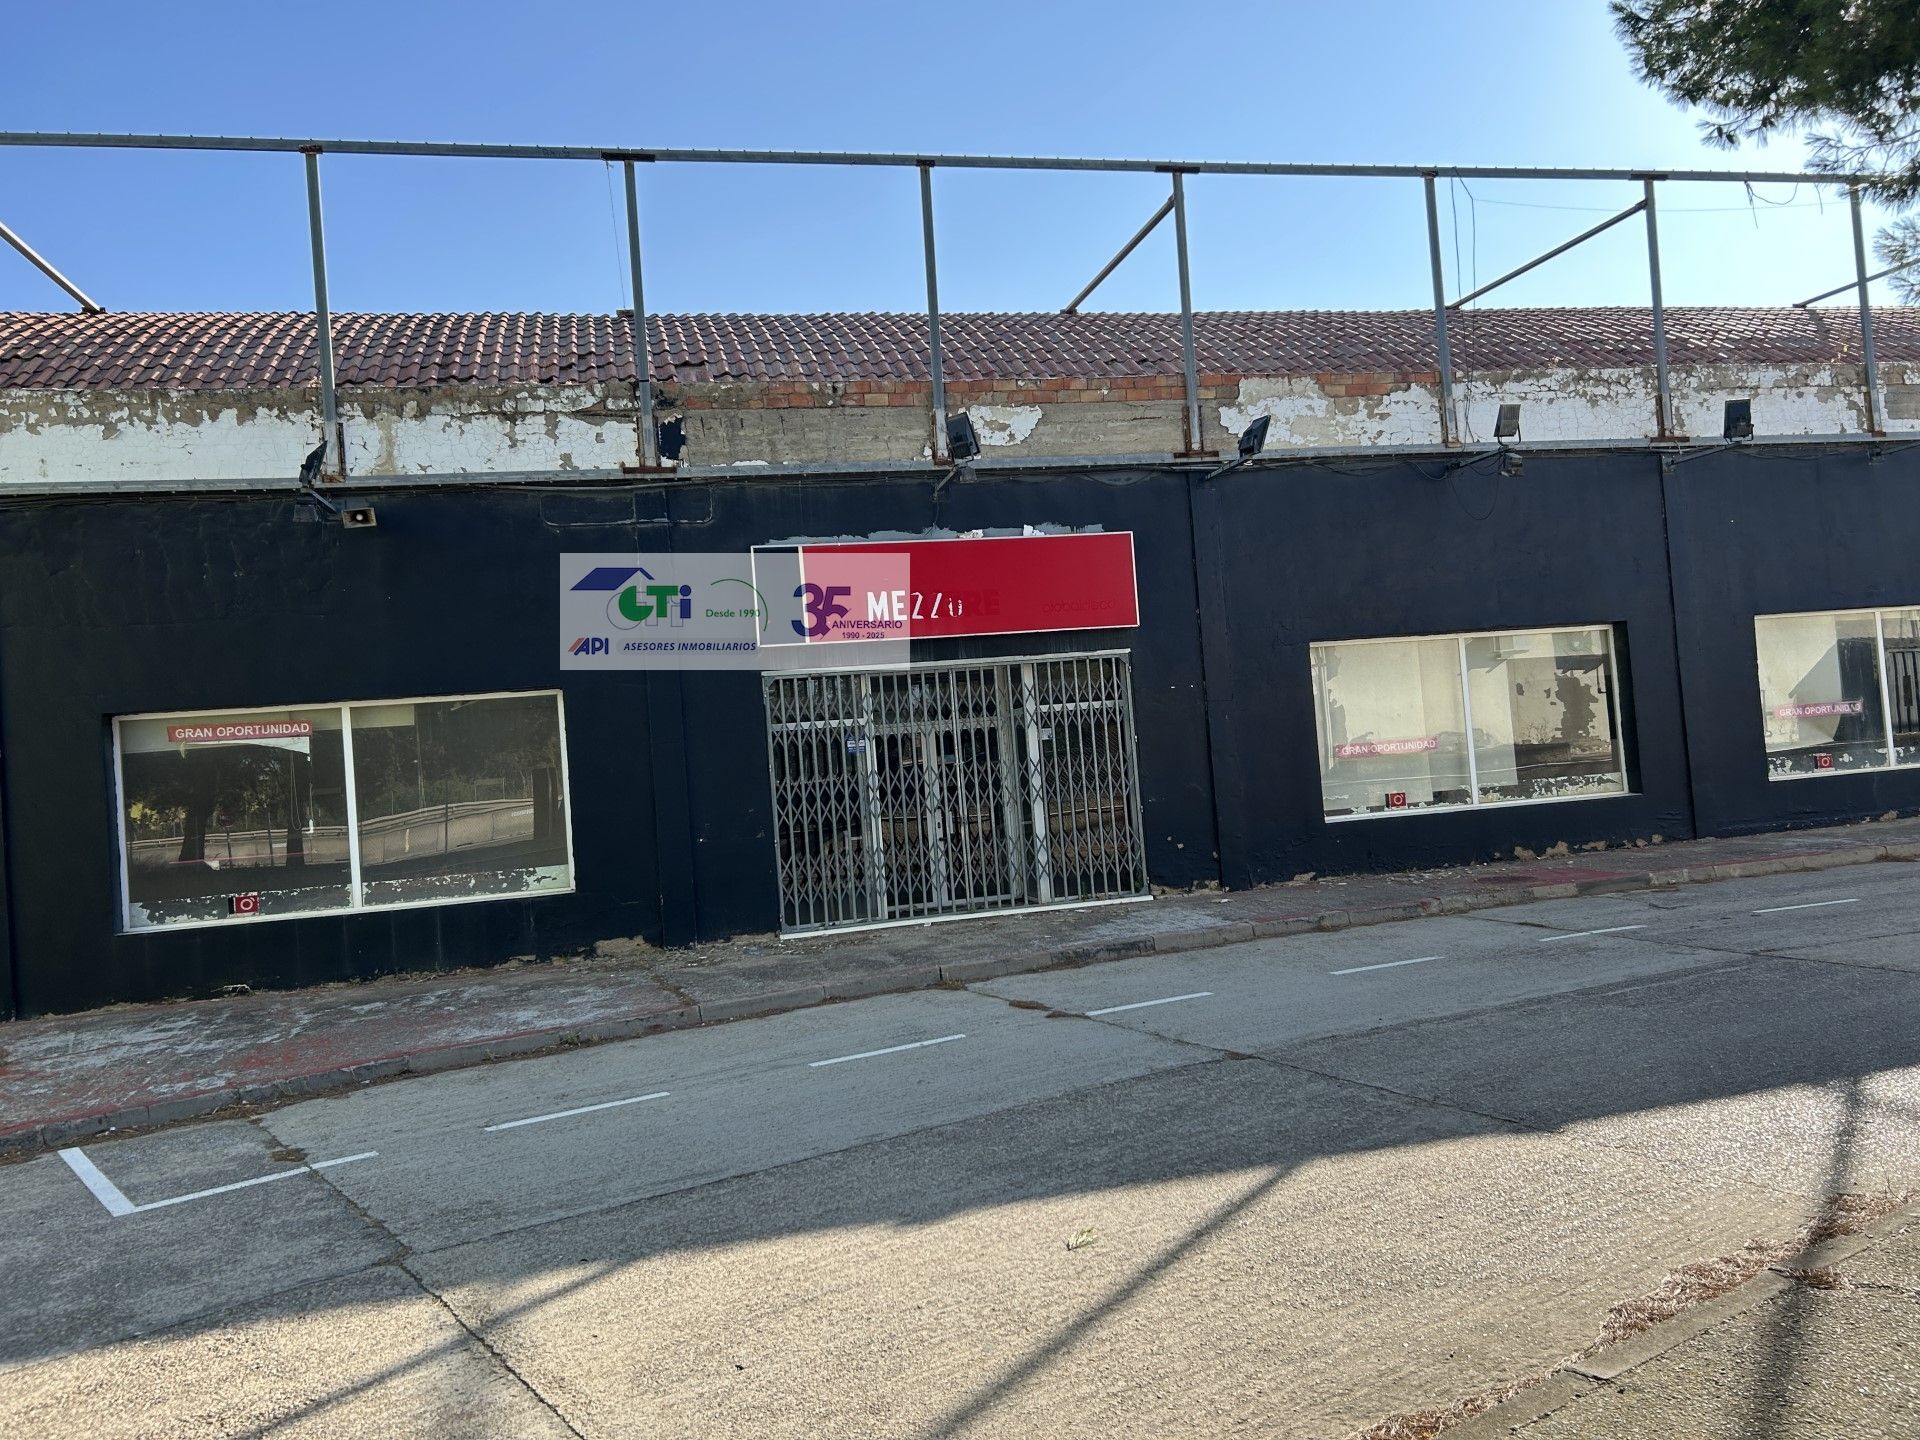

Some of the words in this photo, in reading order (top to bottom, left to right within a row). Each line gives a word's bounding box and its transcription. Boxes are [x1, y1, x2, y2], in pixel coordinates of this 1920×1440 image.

[1780, 706, 1802, 717] GRAN
[175, 728, 212, 739] GRAN
[216, 723, 310, 737] OPORTUNIDAD
[1341, 745, 1368, 756] GRAN
[1369, 739, 1436, 753] OPORTUNIDAD
